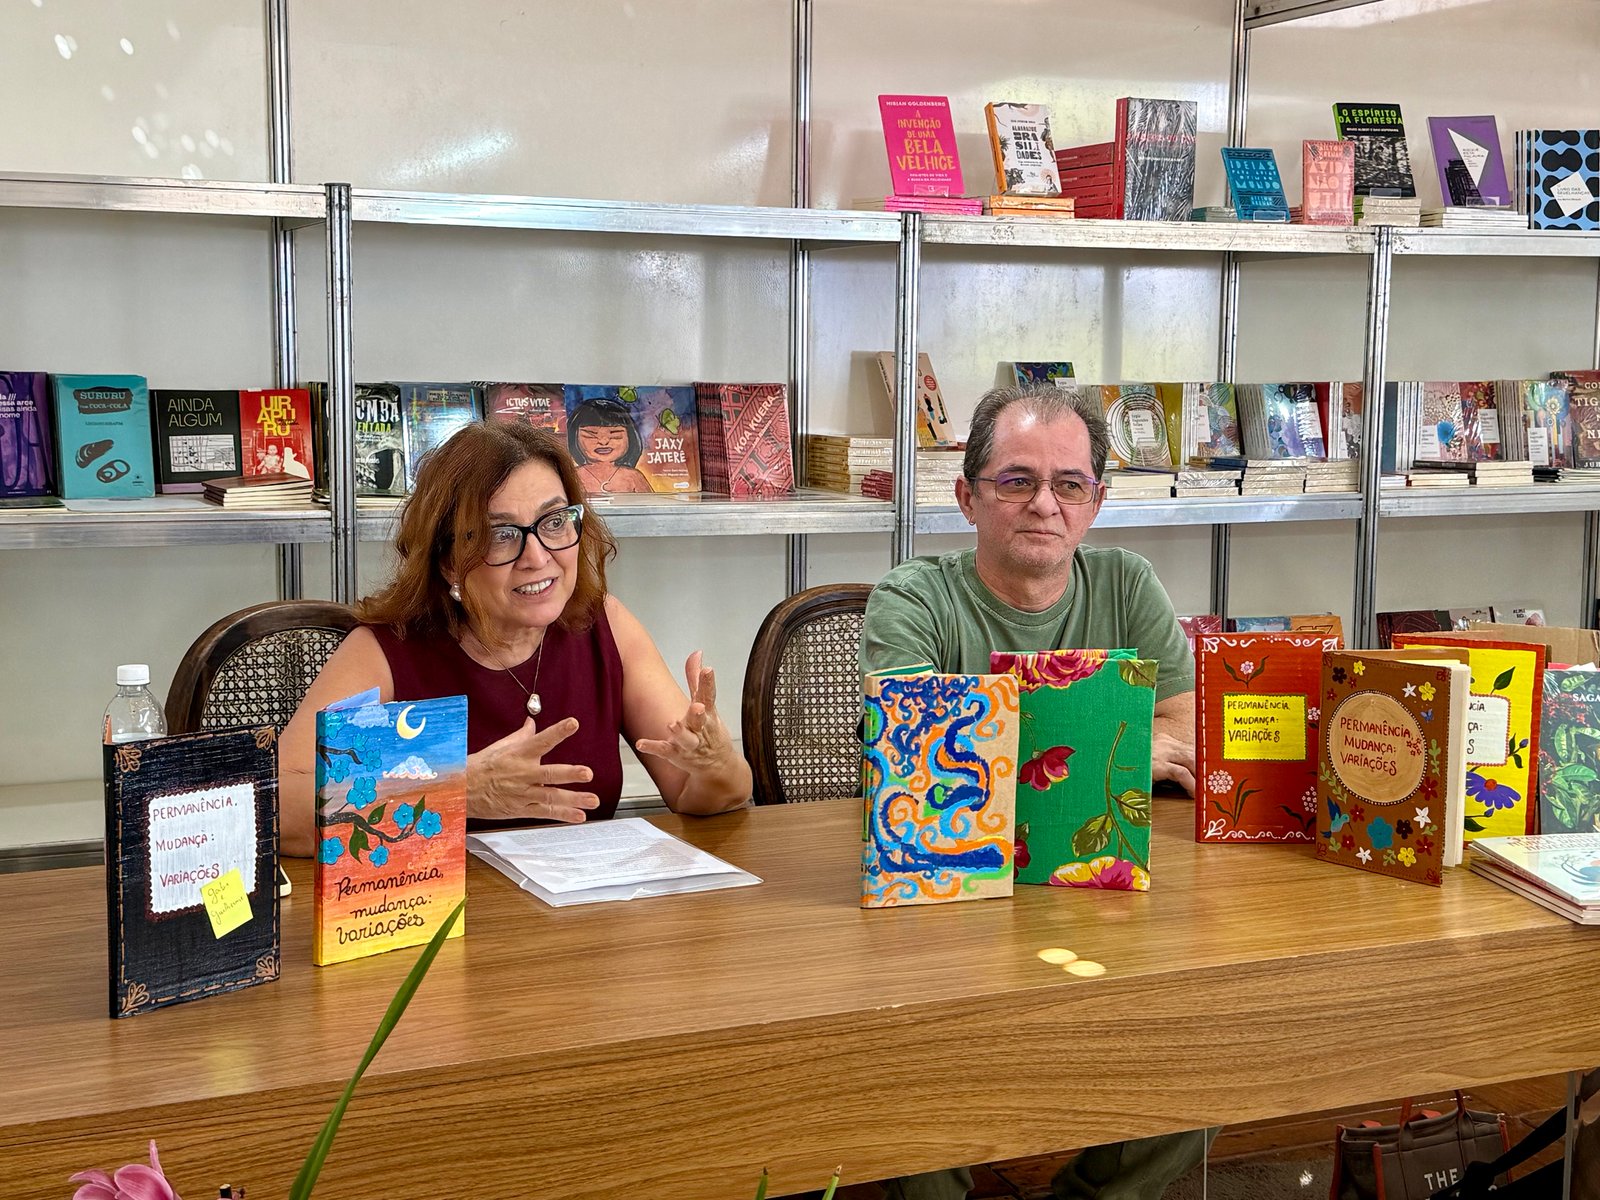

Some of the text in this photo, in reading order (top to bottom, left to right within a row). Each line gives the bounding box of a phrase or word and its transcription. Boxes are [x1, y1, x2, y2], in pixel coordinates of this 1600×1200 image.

[1351, 108, 1397, 117] ESPÍRITO
[897, 117, 942, 130] INVENÇÃO
[1354, 116, 1403, 124] FLORESTA
[907, 130, 936, 138] DE UMA
[904, 139, 944, 155] BELA
[896, 155, 956, 171] VELHICE
[1230, 160, 1275, 170] IDEIAS
[1318, 161, 1350, 174] VIDA
[1235, 180, 1280, 189] MUNDO
[1309, 173, 1340, 189] NÃO
[80, 391, 126, 400] SURURU
[506, 397, 551, 407] ICTUS VITAE
[168, 398, 215, 412] AINDA
[260, 395, 291, 410] UIR
[169, 412, 223, 427] ALGUM
[734, 430, 753, 454] KOA
[748, 395, 778, 431] KUERA
[356, 421, 391, 433] ENTADA
[655, 437, 684, 450] JAXY
[1344, 735, 1397, 755] MUDANÇA:
[1424, 1168, 1458, 1190] THE
